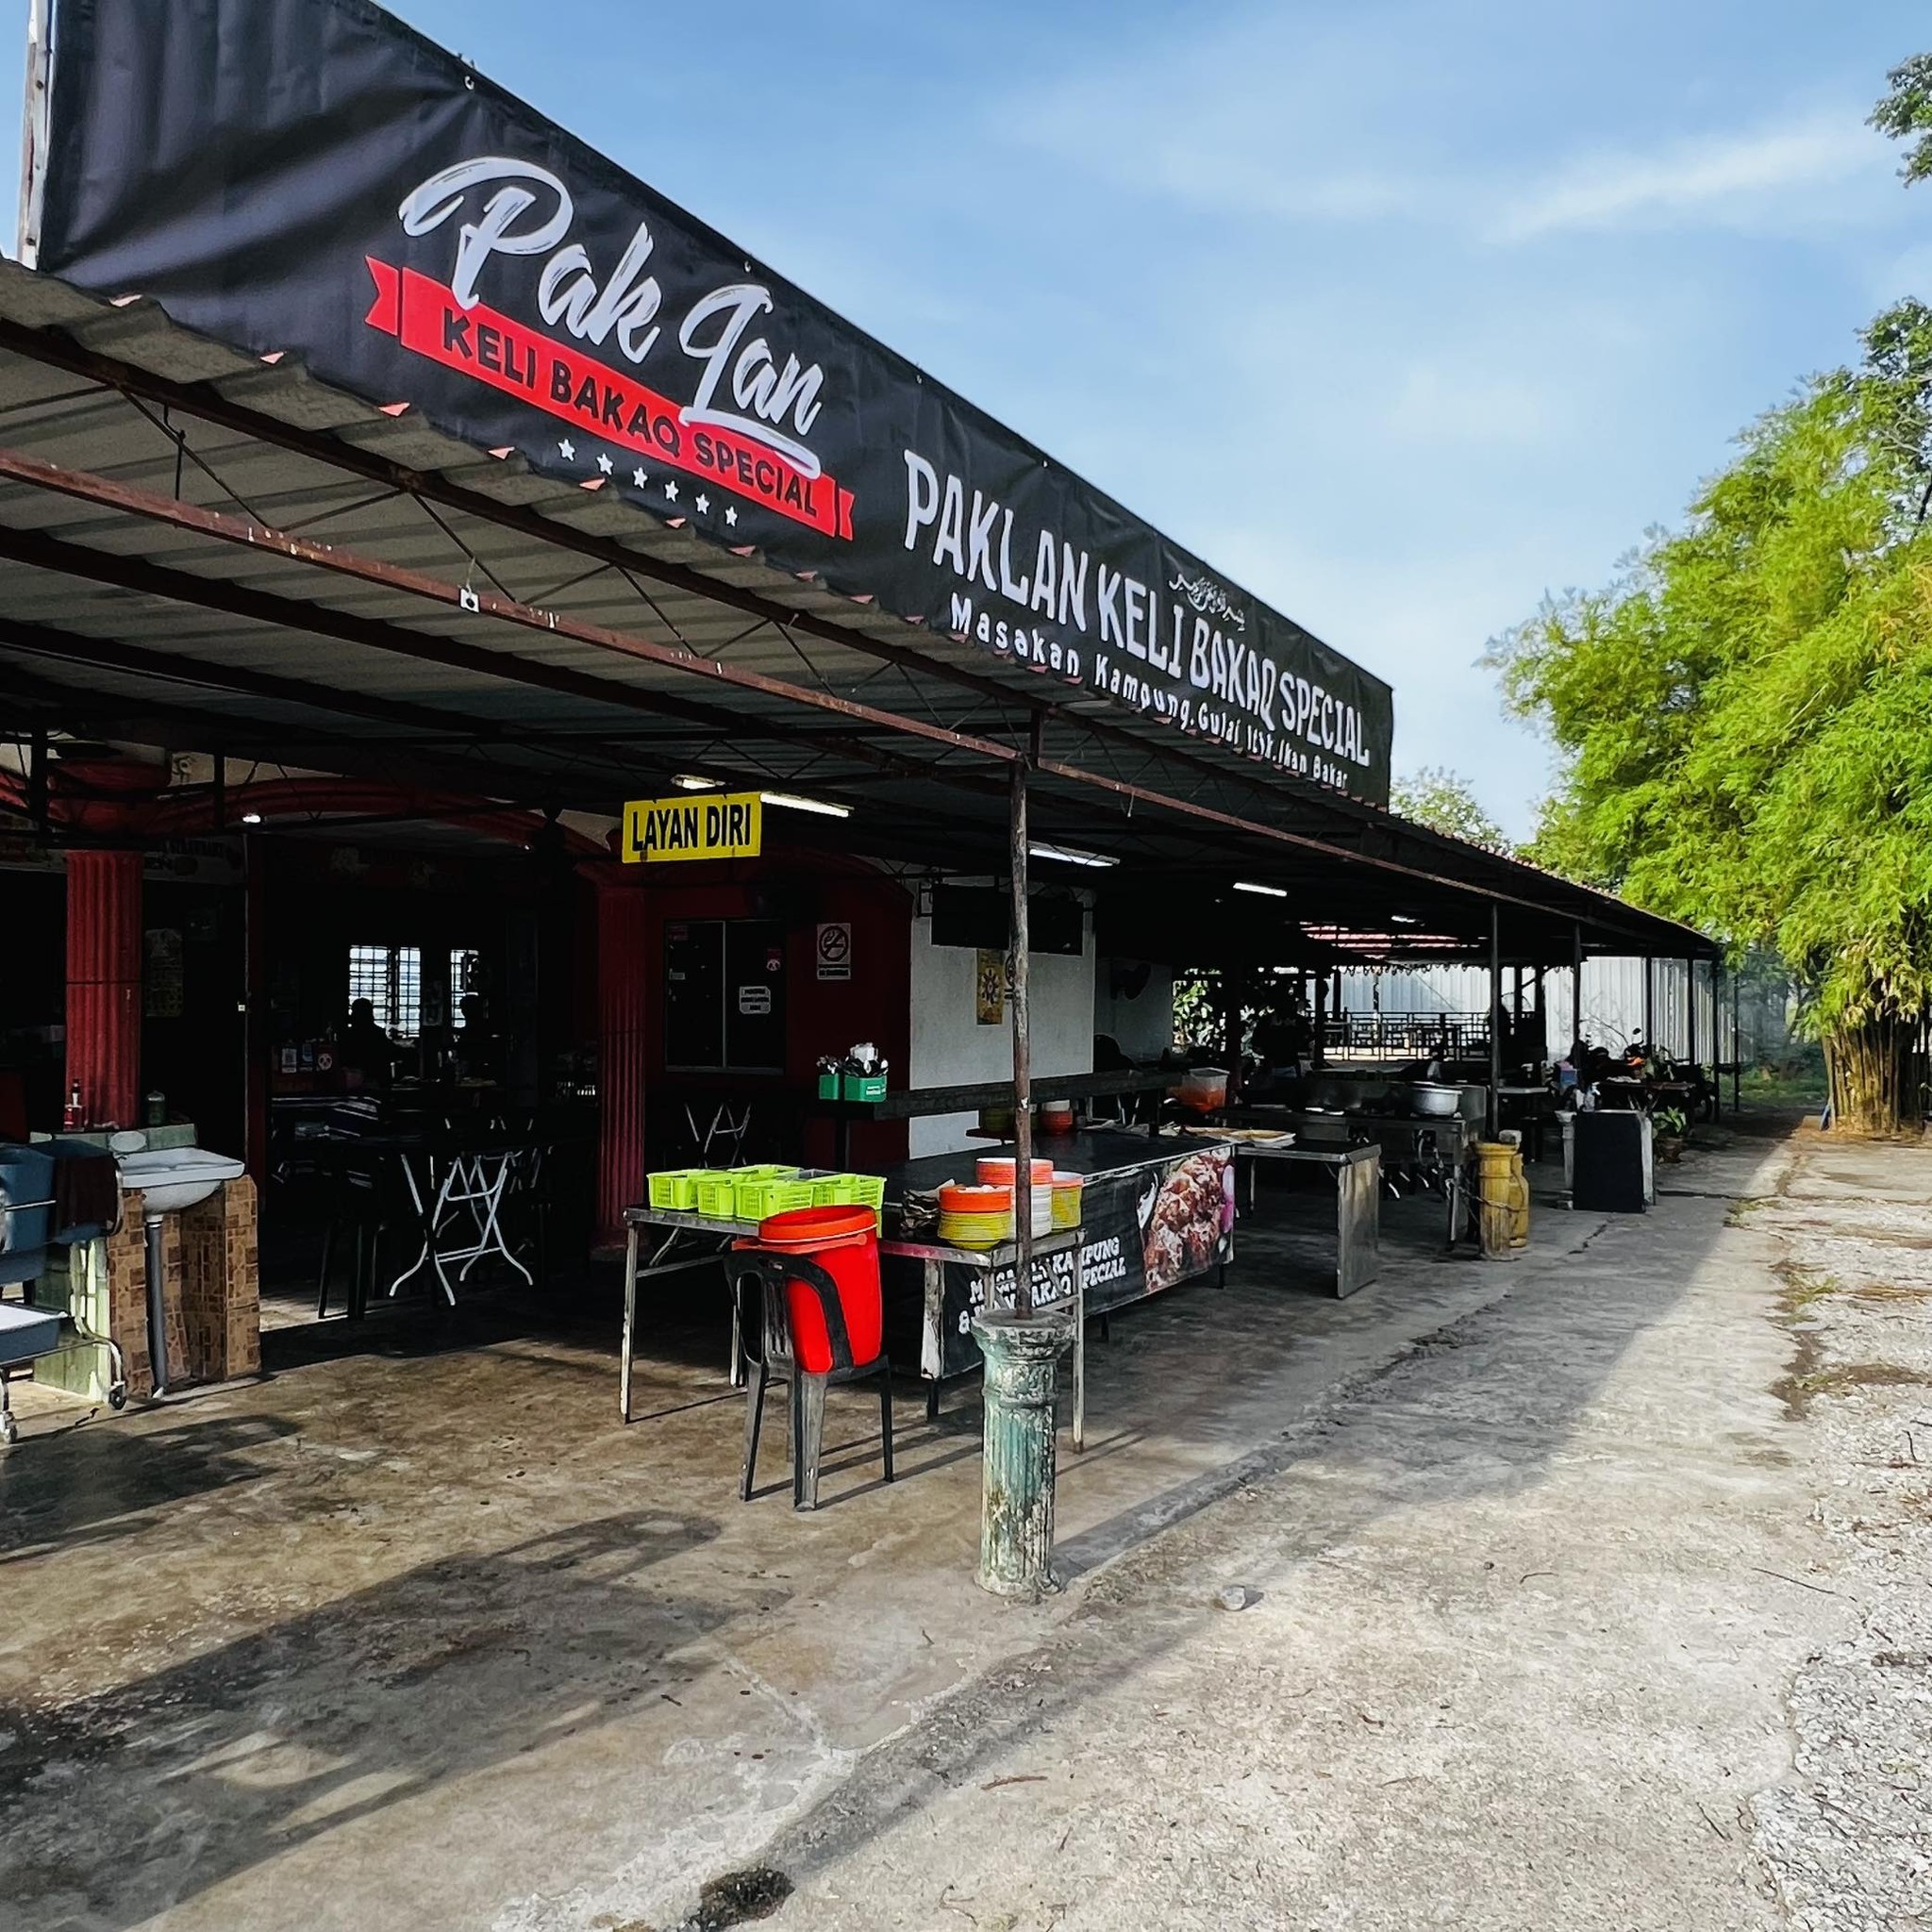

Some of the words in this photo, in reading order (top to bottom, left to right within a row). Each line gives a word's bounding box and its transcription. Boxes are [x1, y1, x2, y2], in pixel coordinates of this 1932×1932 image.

[398, 157, 661, 363] Pak
[444, 308, 536, 390] KELI
[550, 359, 680, 458] BAKAQ
[693, 432, 818, 516] SPECIAL
[904, 449, 1088, 632] PAKLAN
[1097, 564, 1184, 679] KELI
[1190, 618, 1275, 732] BAKAQ
[1280, 671, 1370, 767] SPECIAL
[951, 591, 1080, 677] Masakan
[1312, 755, 1348, 790] Bakar
[631, 807, 699, 852] LAYAN
[706, 803, 751, 848] DIRI
[1082, 1257, 1126, 1290] PECIAL
